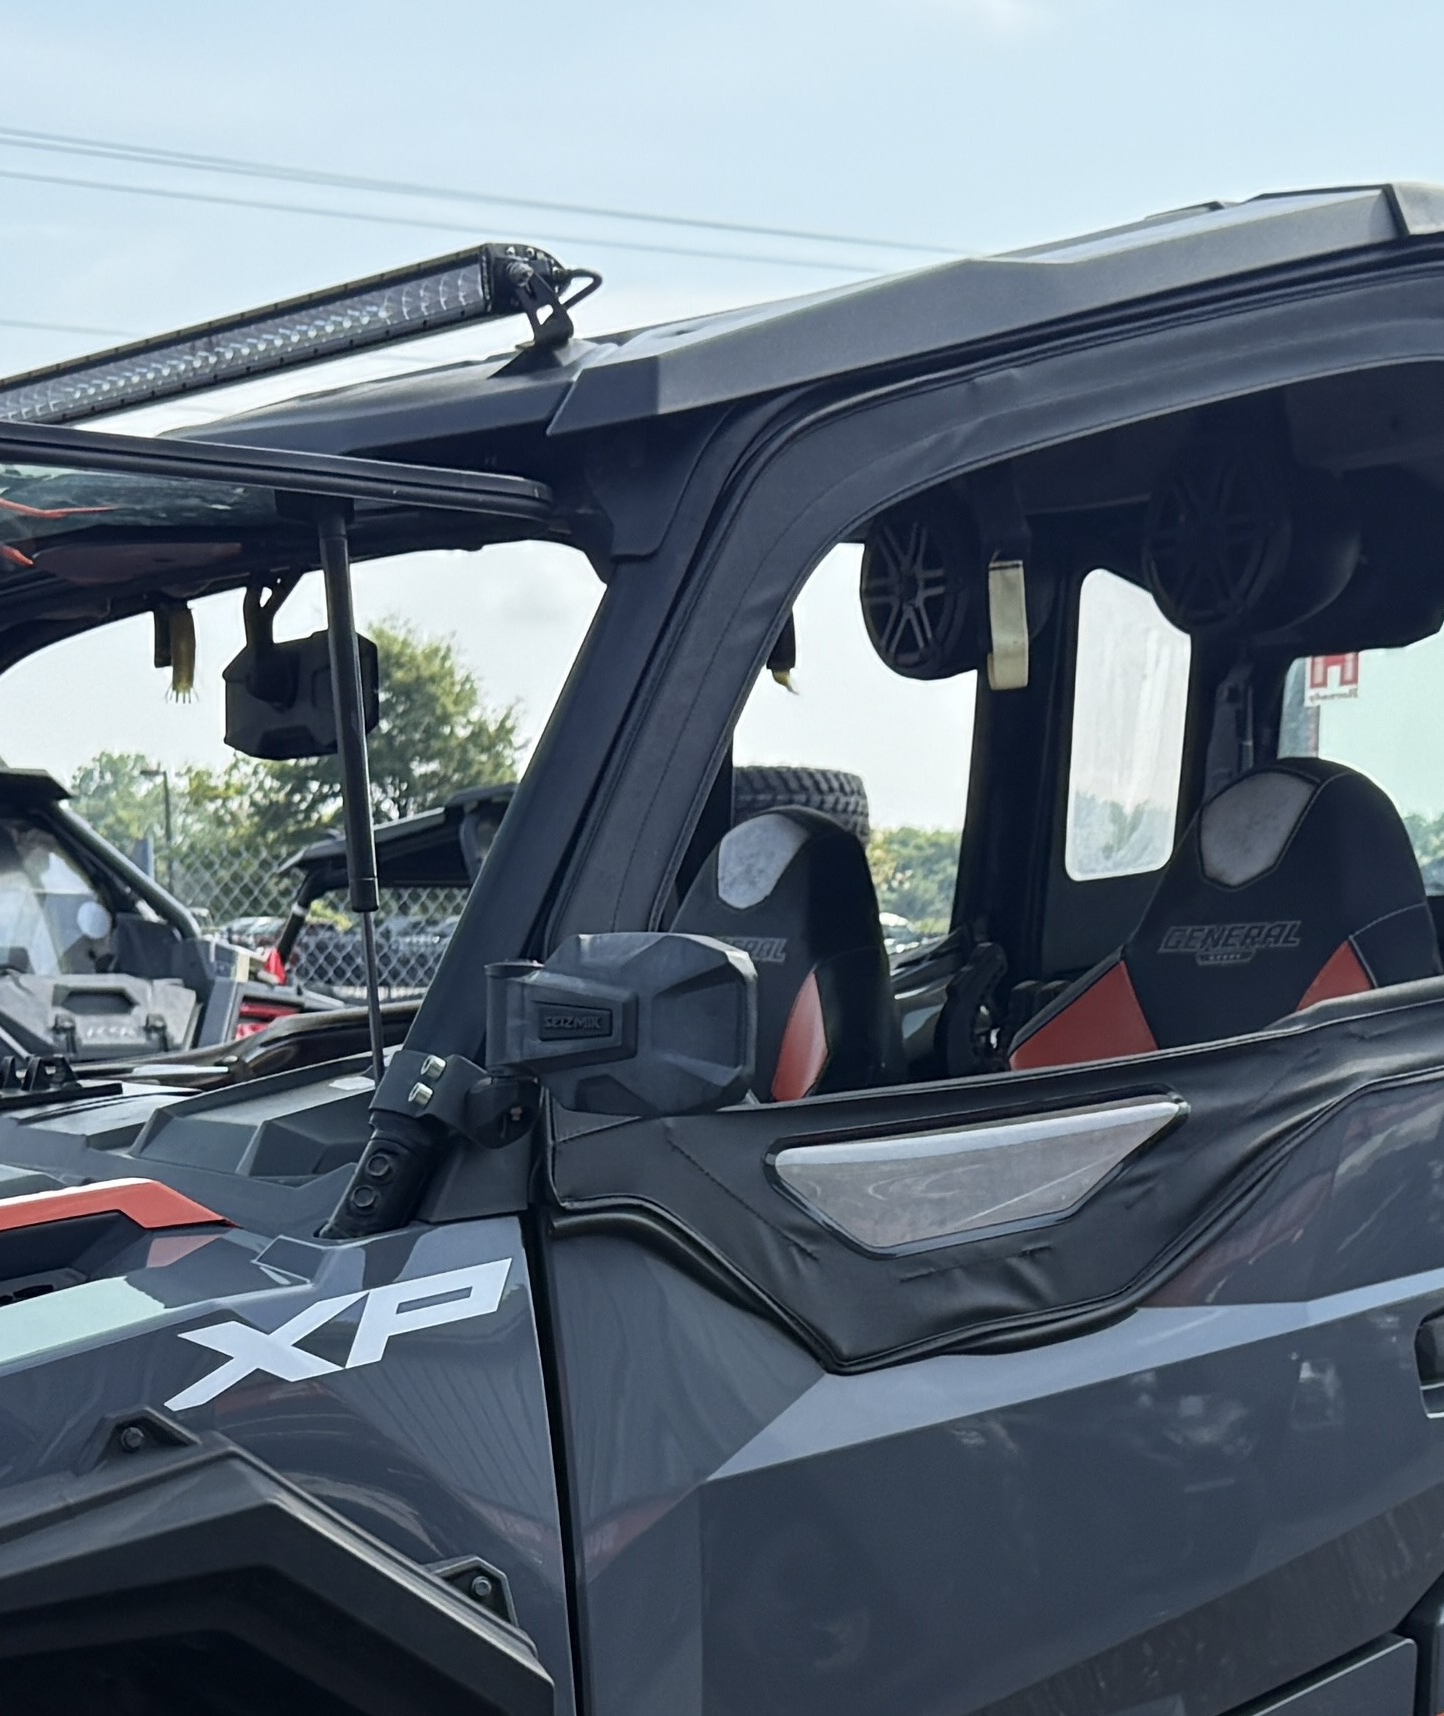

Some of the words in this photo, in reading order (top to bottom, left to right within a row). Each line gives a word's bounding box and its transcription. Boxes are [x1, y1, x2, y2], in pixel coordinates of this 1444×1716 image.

[1157, 921, 1302, 953] GENERAL
[544, 1015, 604, 1030] SEIZMIK
[164, 1257, 512, 1411] XP
